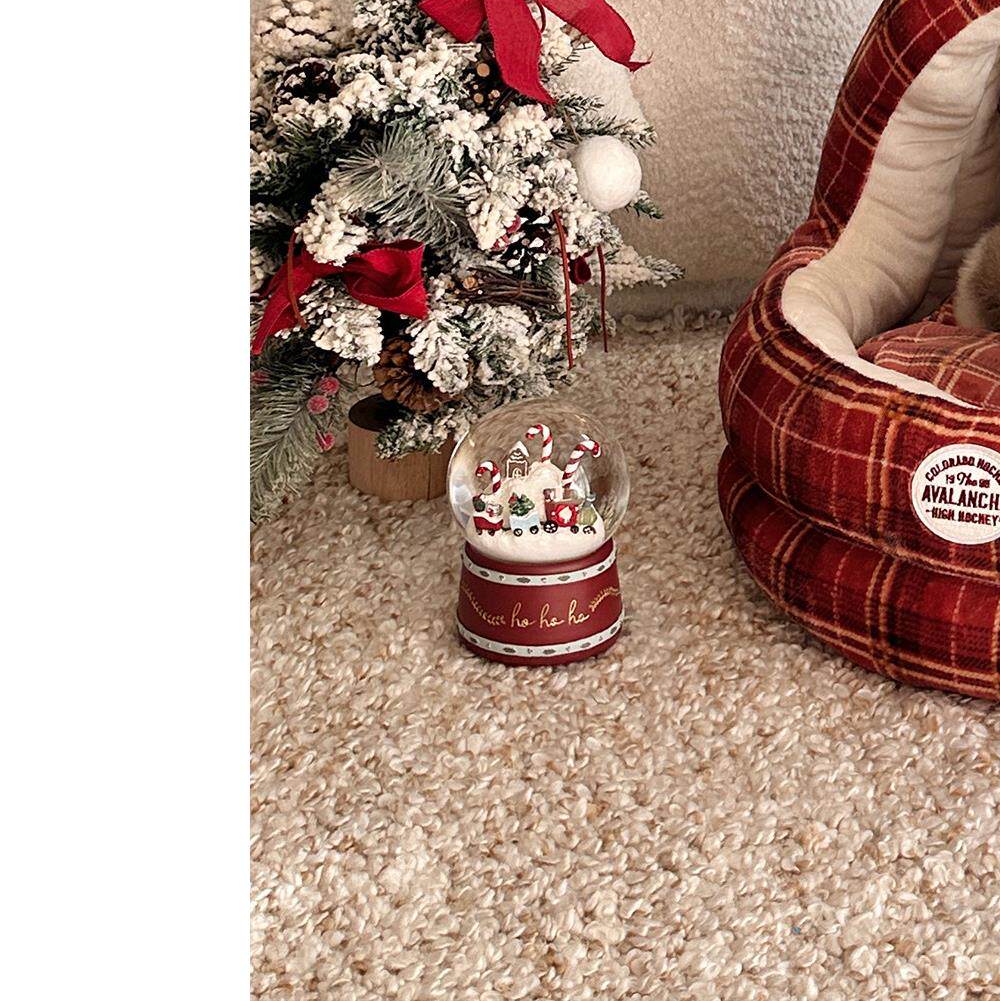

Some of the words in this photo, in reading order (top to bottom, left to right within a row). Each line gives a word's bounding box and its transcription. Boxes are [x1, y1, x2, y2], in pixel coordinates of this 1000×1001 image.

[925, 455, 975, 482] COLORADO
[957, 472, 977, 487] The
[511, 602, 535, 628] ho
[540, 603, 565, 629] ho
